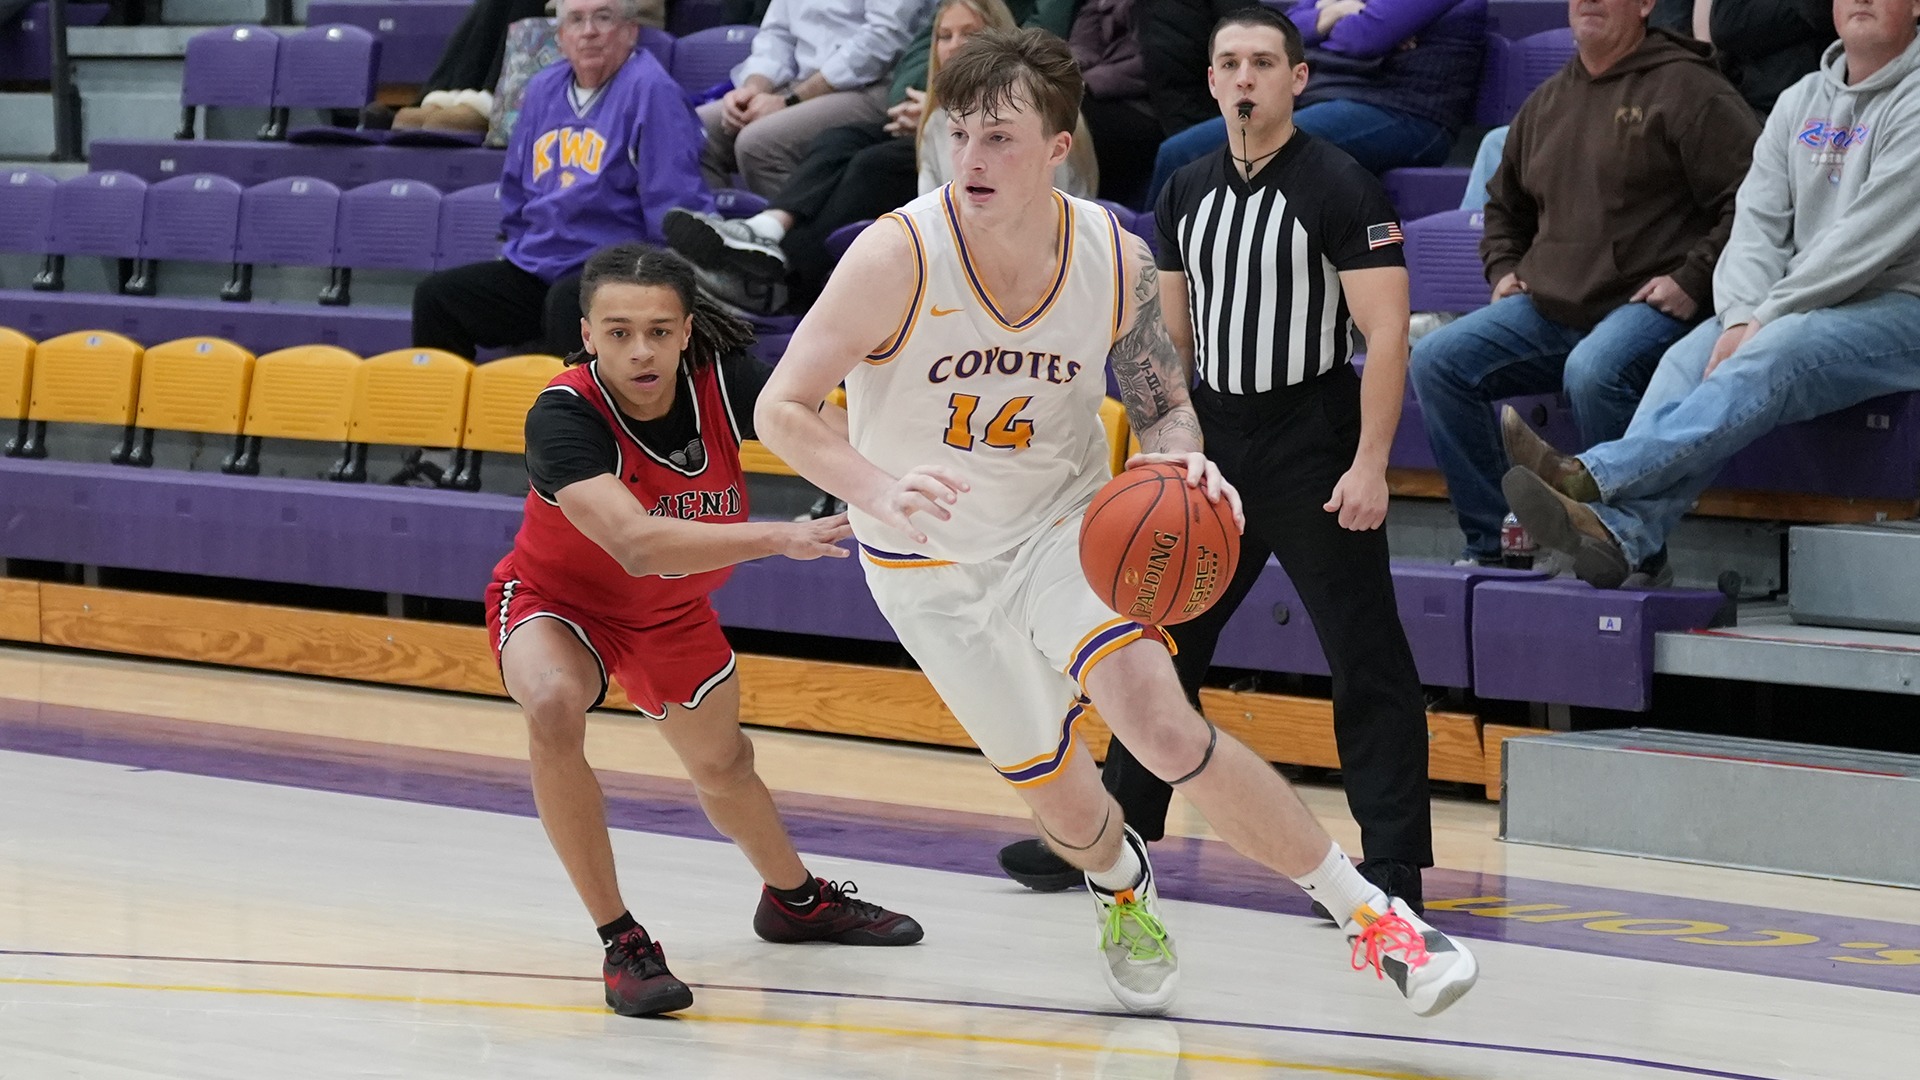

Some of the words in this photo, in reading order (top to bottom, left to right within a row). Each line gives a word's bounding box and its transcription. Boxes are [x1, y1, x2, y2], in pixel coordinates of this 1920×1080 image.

[532, 126, 607, 184] KWU
[928, 346, 1081, 384] COYOTES
[943, 393, 1034, 452] 14
